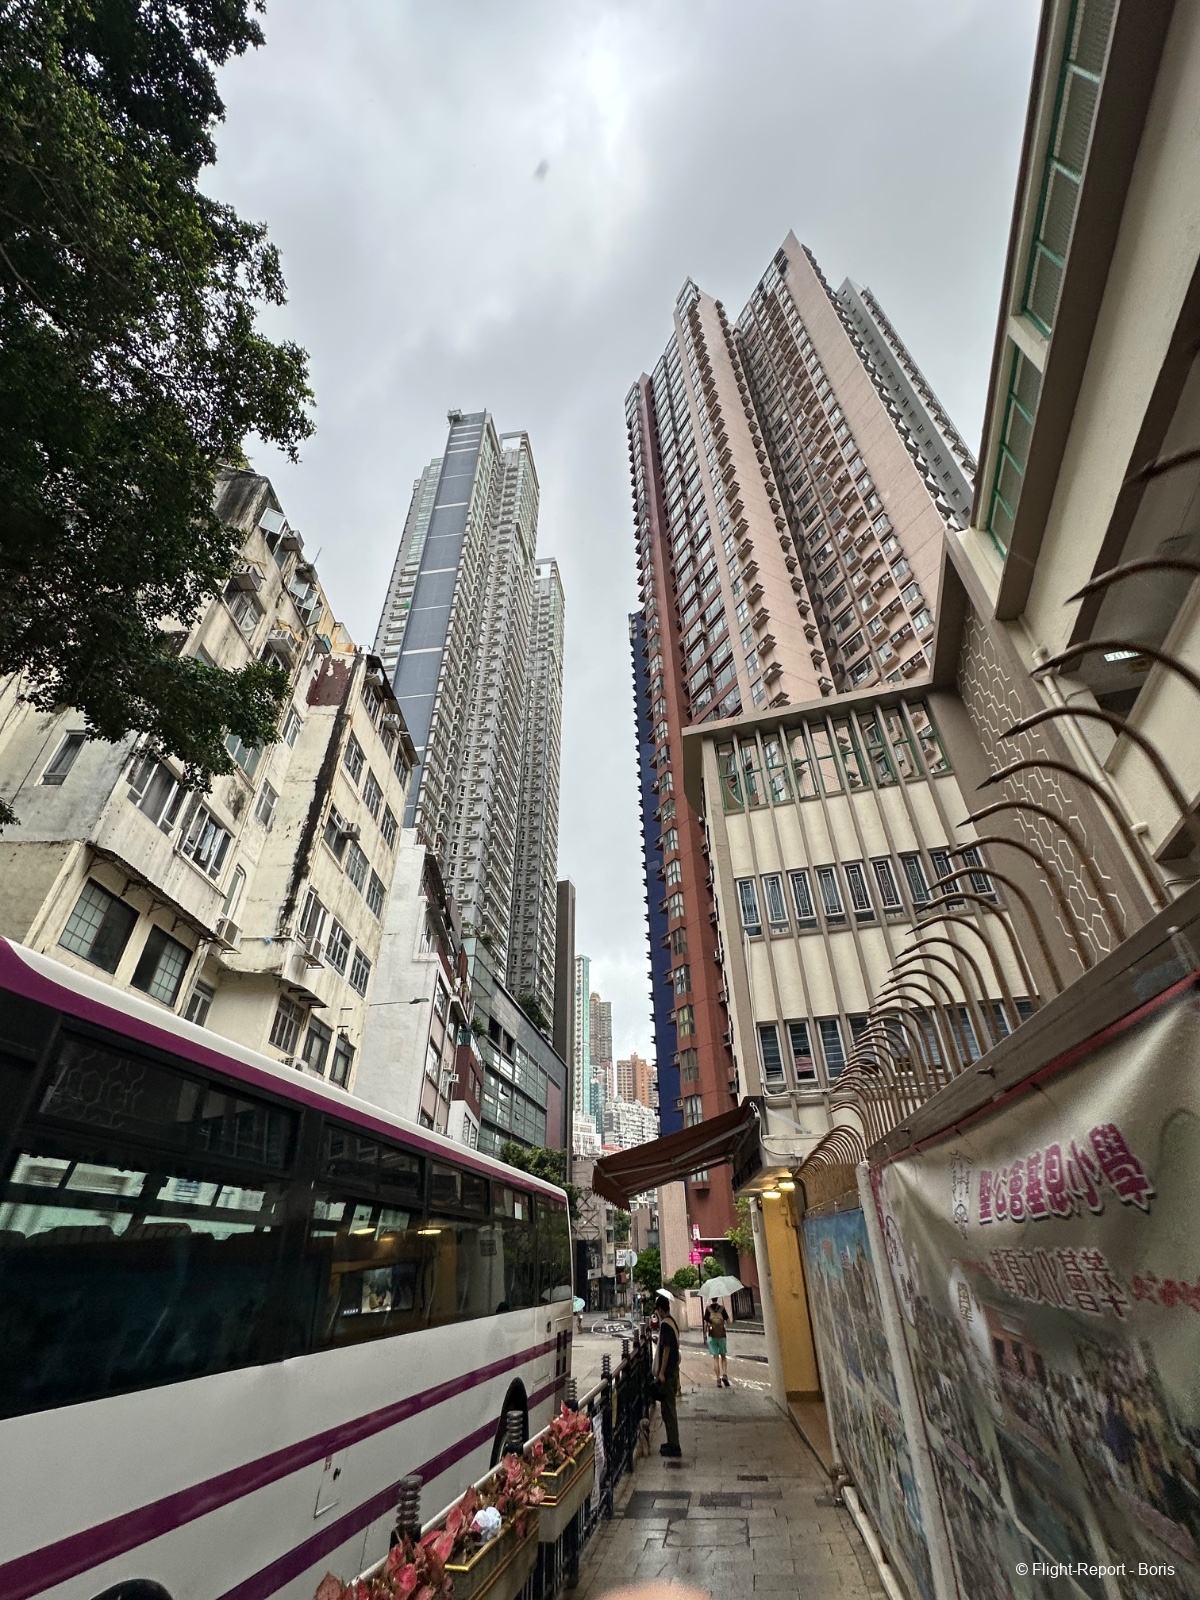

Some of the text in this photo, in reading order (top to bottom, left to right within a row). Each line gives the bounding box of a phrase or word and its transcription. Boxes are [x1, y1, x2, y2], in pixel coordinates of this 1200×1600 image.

[979, 1122, 1155, 1223] 聖公會基恩小學
